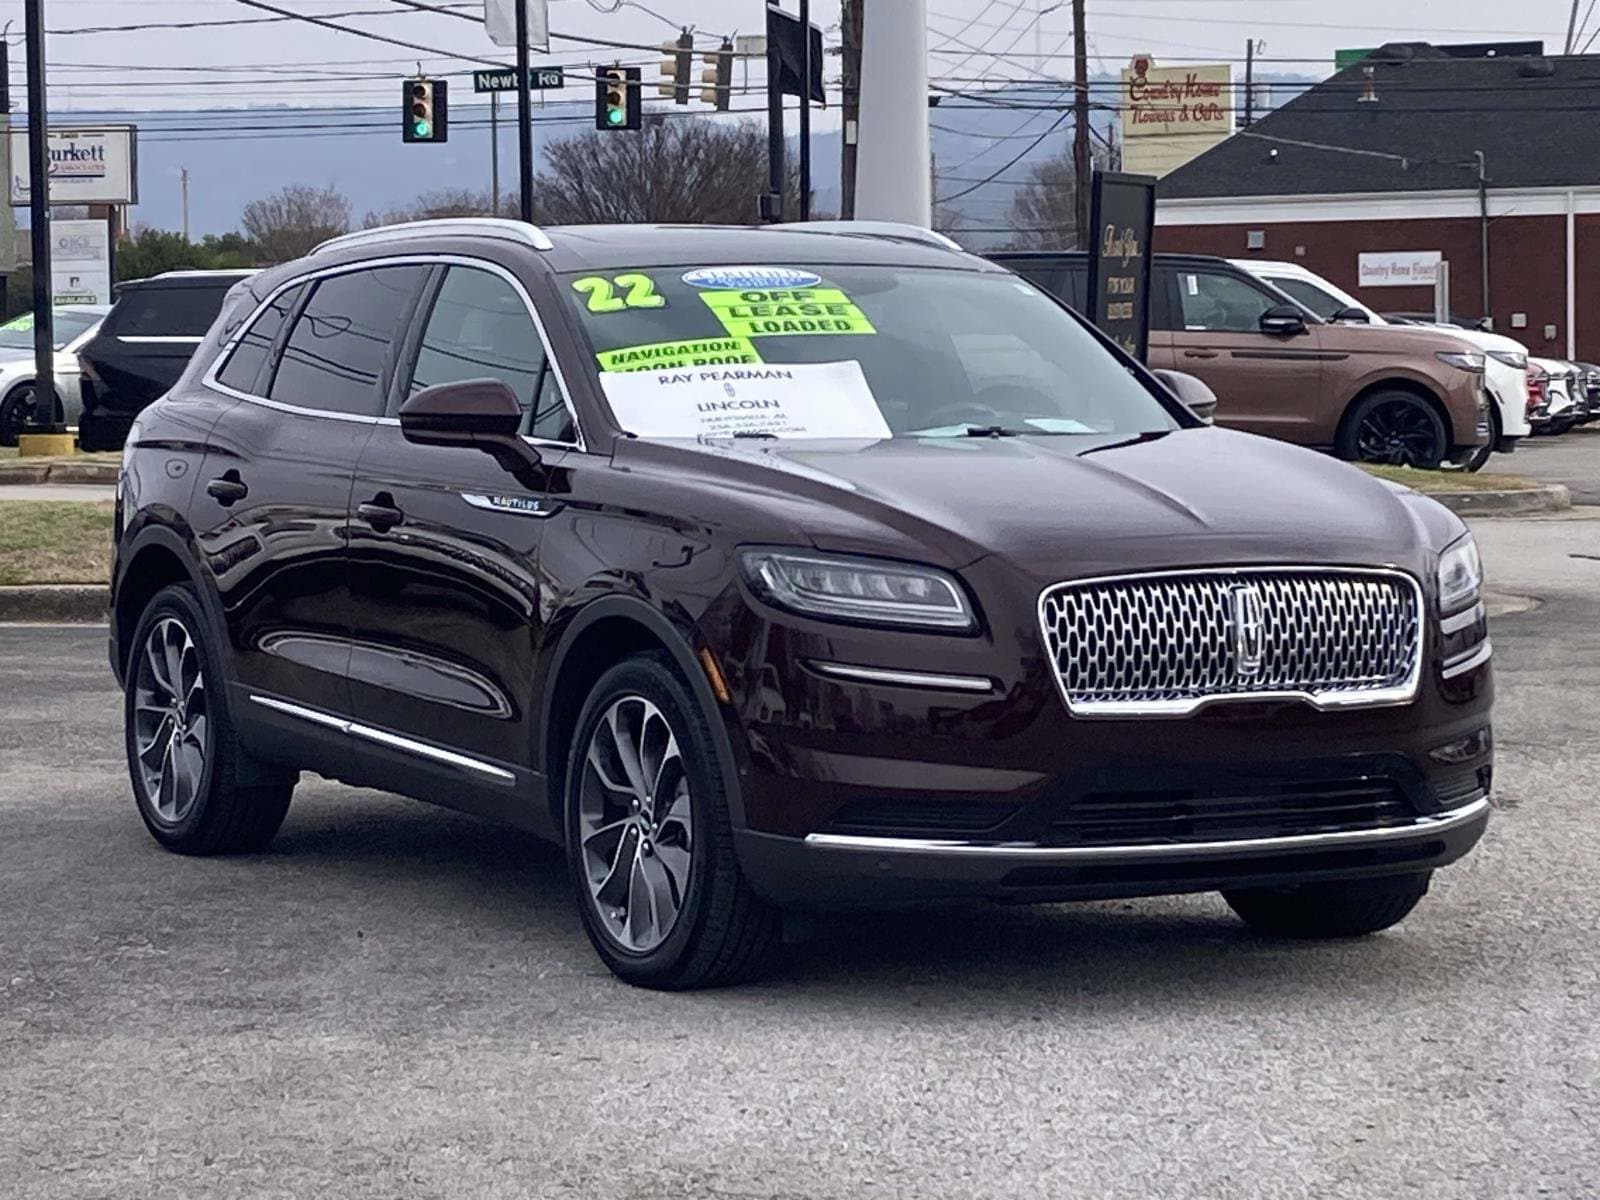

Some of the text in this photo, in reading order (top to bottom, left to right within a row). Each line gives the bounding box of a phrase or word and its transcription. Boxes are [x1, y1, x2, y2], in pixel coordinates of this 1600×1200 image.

[478, 72, 559, 88] New Rd
[49, 142, 105, 161] urkett
[571, 273, 666, 312] 22
[739, 290, 816, 303] OFF
[729, 304, 849, 318] LEASE
[750, 319, 852, 333] LOADED
[611, 341, 739, 365] NAVIGATION
[658, 370, 793, 385] RAY PEARMAN
[697, 399, 780, 412] LINCOLN
[493, 496, 539, 510] NAUTILUS
